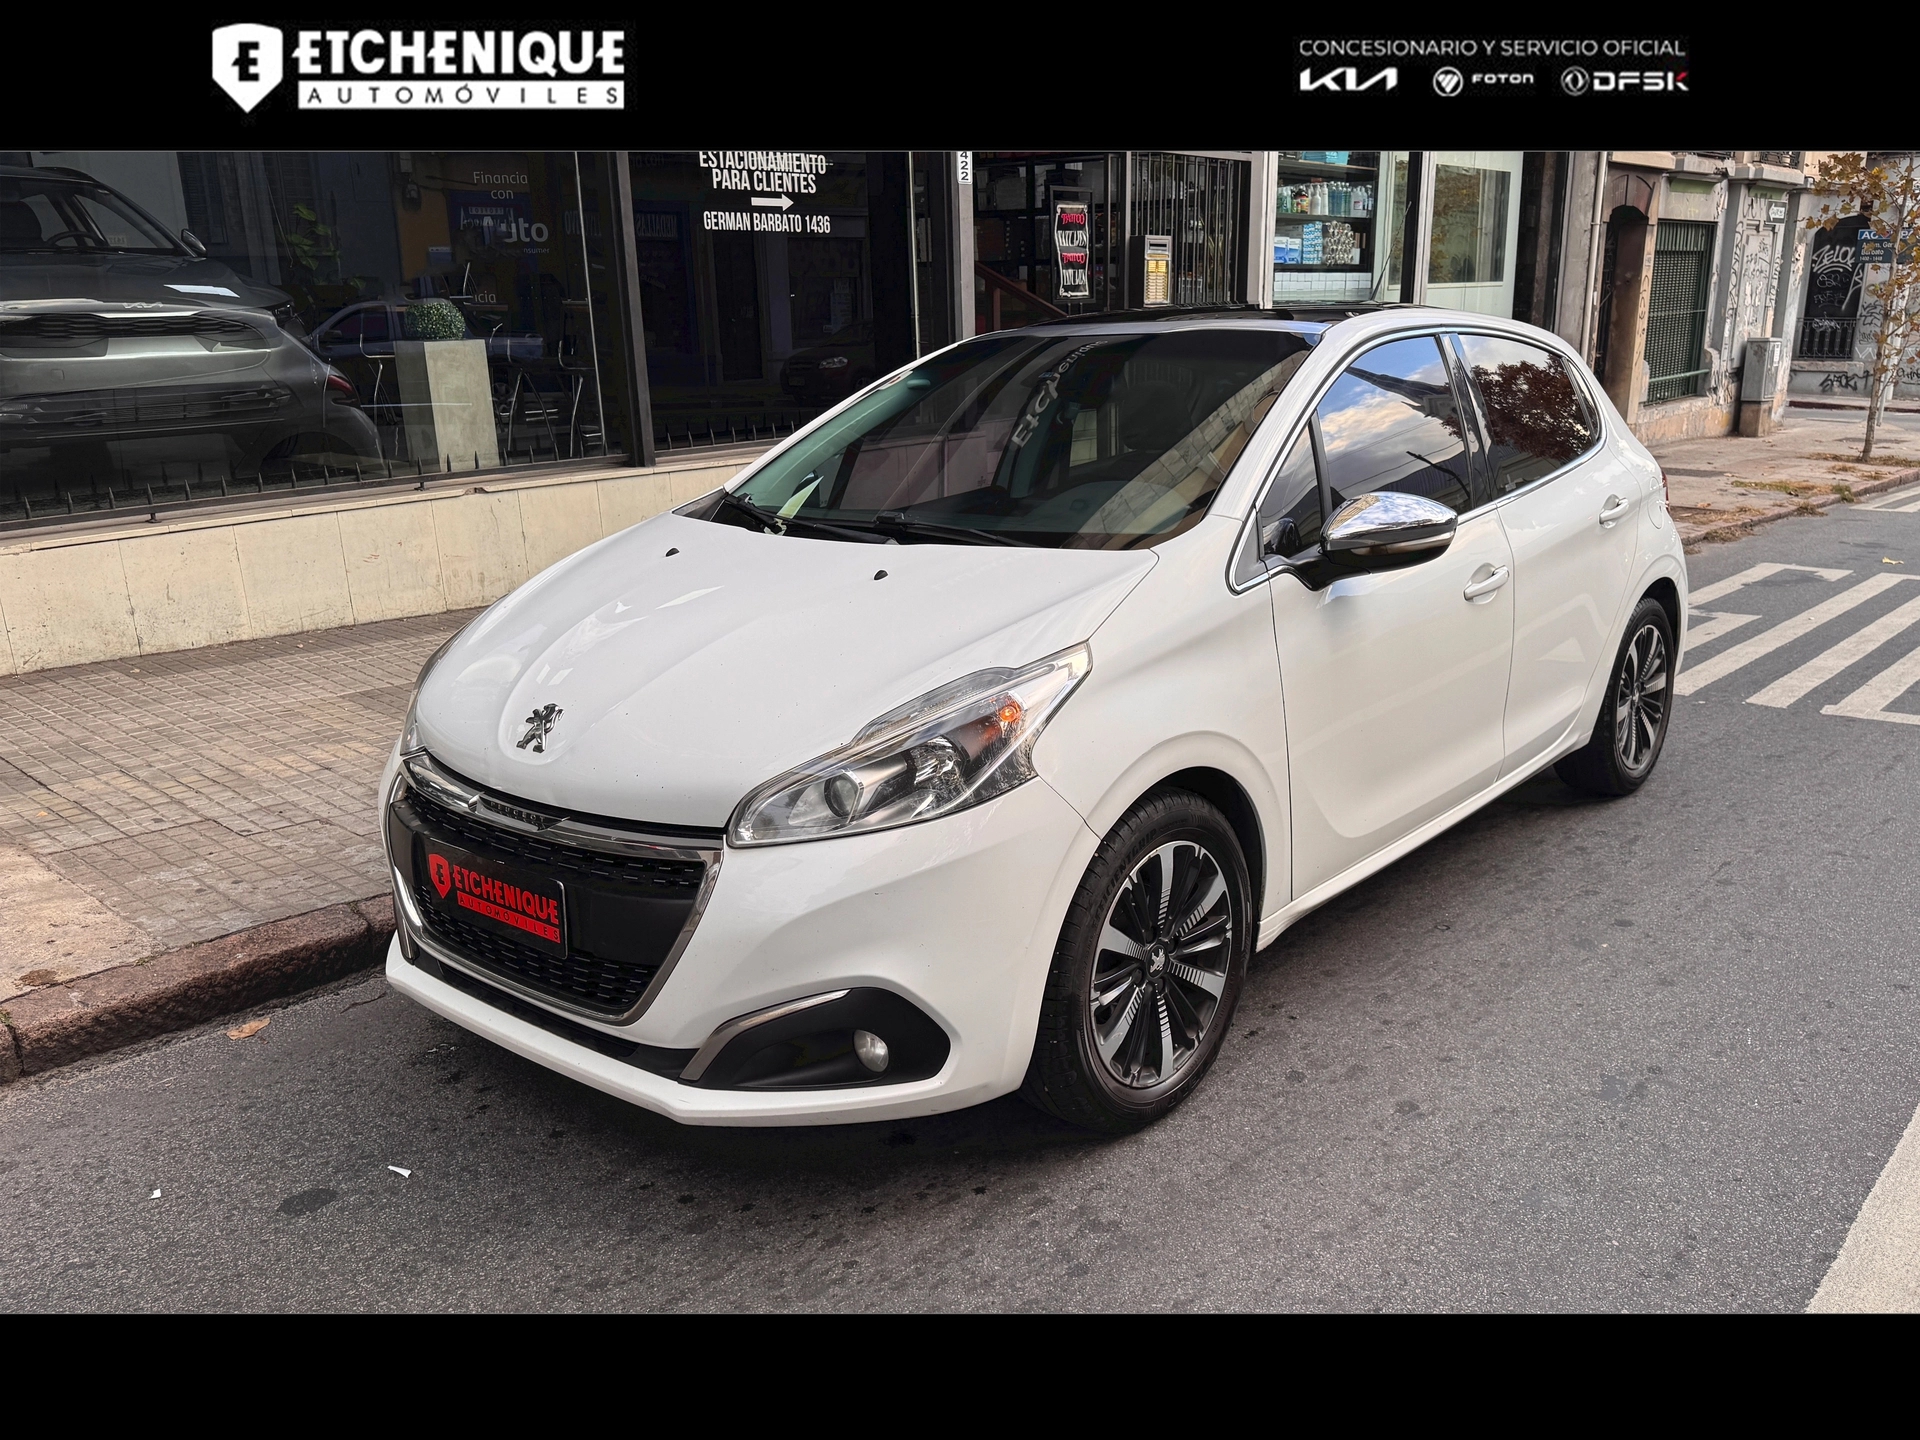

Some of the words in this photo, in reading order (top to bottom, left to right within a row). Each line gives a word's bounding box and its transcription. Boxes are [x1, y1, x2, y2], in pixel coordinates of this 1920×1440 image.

[699, 151, 827, 175] ESTACIONAMIENTO
[473, 171, 528, 184] Financia
[712, 168, 750, 190] PARA
[753, 170, 816, 194] CLIENTES
[490, 189, 514, 200] con
[703, 211, 750, 231] GERMAN
[753, 212, 802, 233] BARBATO
[805, 214, 831, 234] 1436
[1061, 213, 1085, 225] TATTOO
[452, 864, 560, 925] ETCHENIQUE
[459, 894, 560, 941] AUTOMÓVILES
